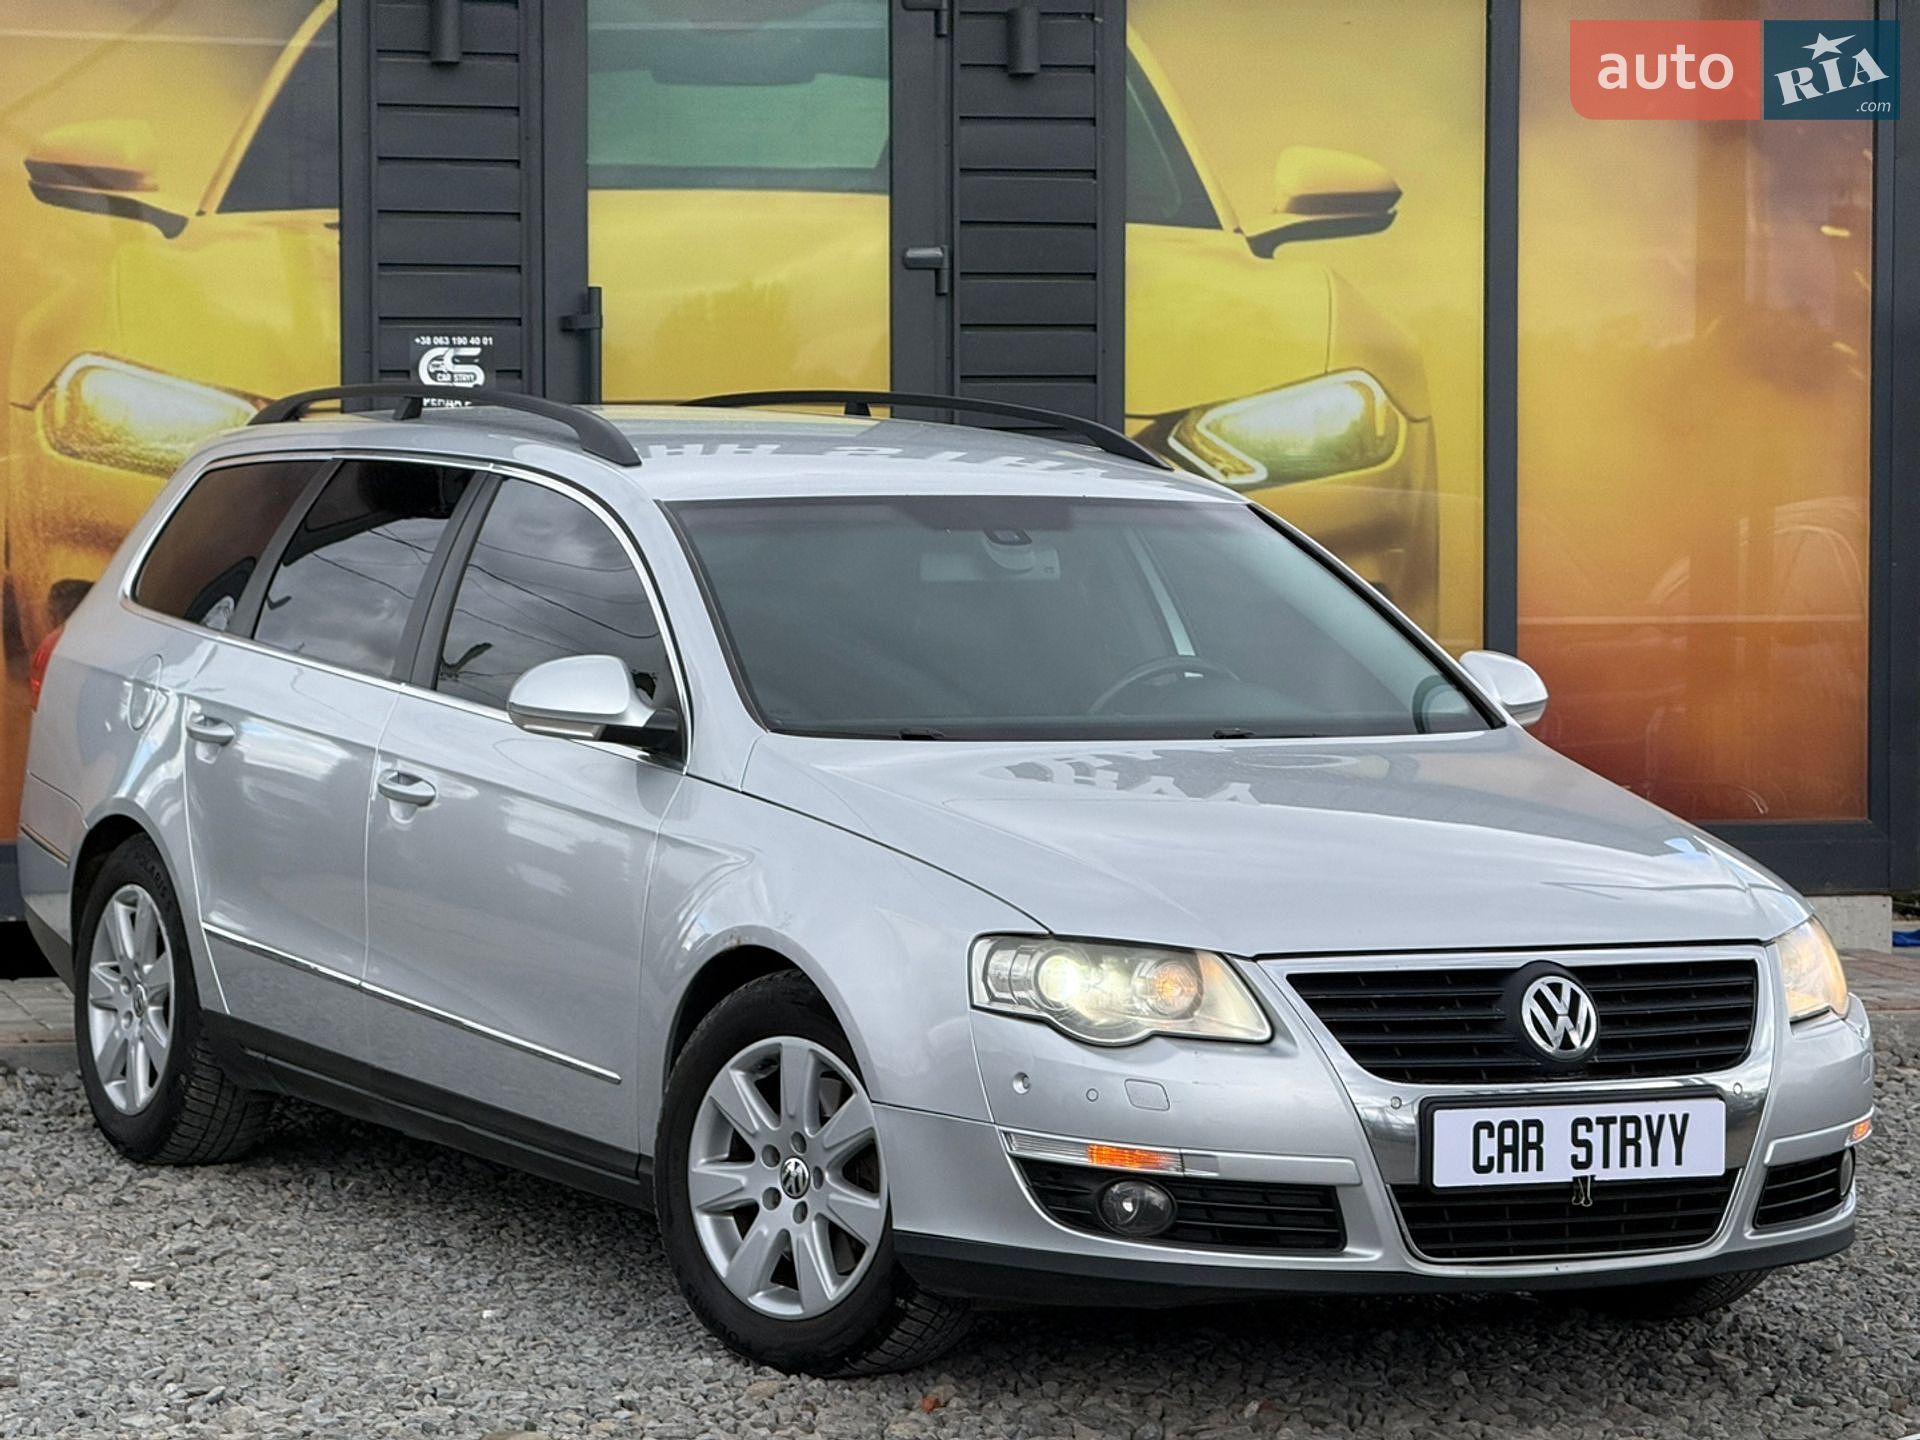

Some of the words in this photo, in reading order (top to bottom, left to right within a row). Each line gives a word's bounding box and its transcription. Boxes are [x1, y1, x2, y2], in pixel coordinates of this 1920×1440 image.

[414, 336, 431, 345] +38
[482, 336, 493, 345] 01
[1472, 1119, 1544, 1174] CAR
[1570, 1113, 1690, 1170] STRYY
